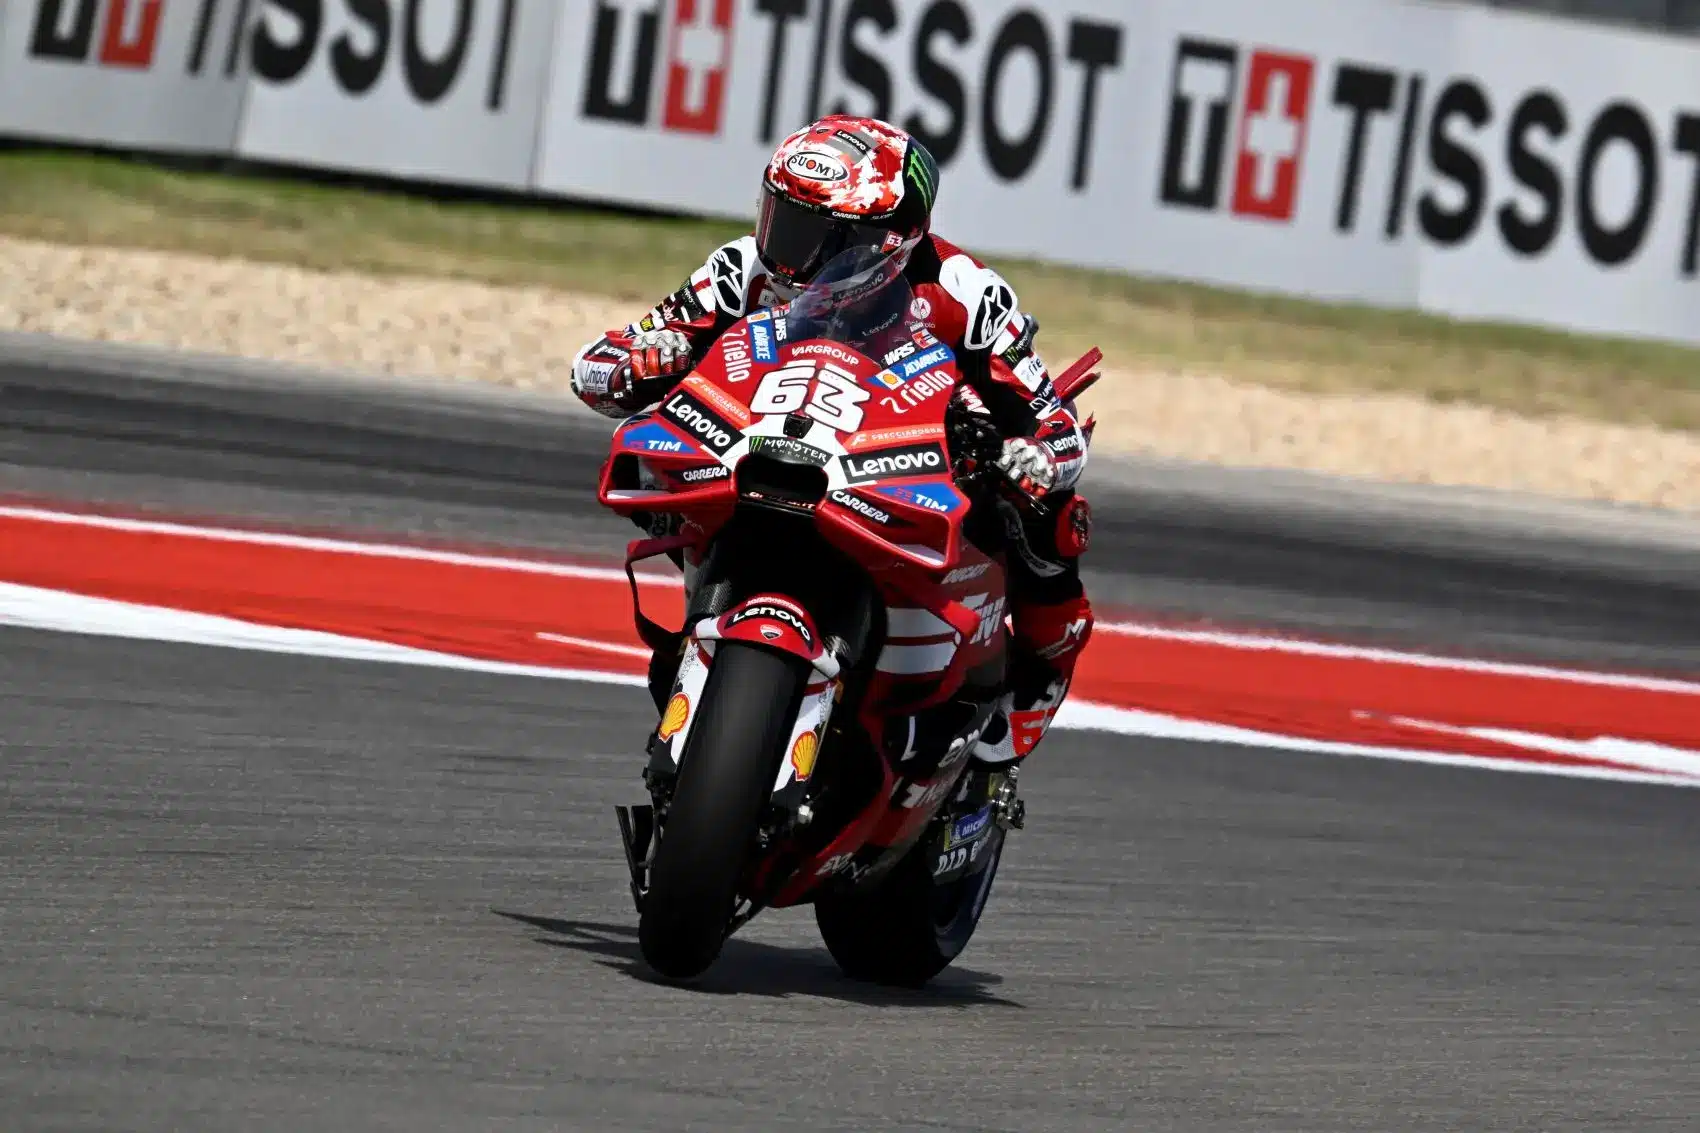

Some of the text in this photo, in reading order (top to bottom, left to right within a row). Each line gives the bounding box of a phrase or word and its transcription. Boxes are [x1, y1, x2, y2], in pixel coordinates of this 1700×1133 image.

[754, 0, 1124, 193] TISSOT
[836, 130, 867, 151] Lenovo
[791, 154, 844, 181] SUOMY
[1333, 60, 1700, 279] TISSOT
[832, 211, 861, 221] CARRERA
[886, 234, 904, 248] 63
[722, 339, 753, 383] riello
[791, 344, 859, 367] VARGROUP
[883, 341, 916, 366] WRS
[903, 347, 949, 378] ADVANCE
[750, 359, 871, 433] 63
[900, 369, 955, 407] riello
[700, 383, 749, 421] FRECCIAROSSA
[665, 394, 731, 447] Lenovo
[648, 440, 682, 452] TIM
[871, 427, 944, 441] FRECCIAROSSA
[764, 438, 827, 463] MONSTER
[683, 466, 728, 482] CARRERA
[846, 451, 940, 477] Lenovo
[831, 490, 890, 524] CARRERA
[915, 493, 949, 512] TIM
[733, 606, 811, 641] Lenovo
